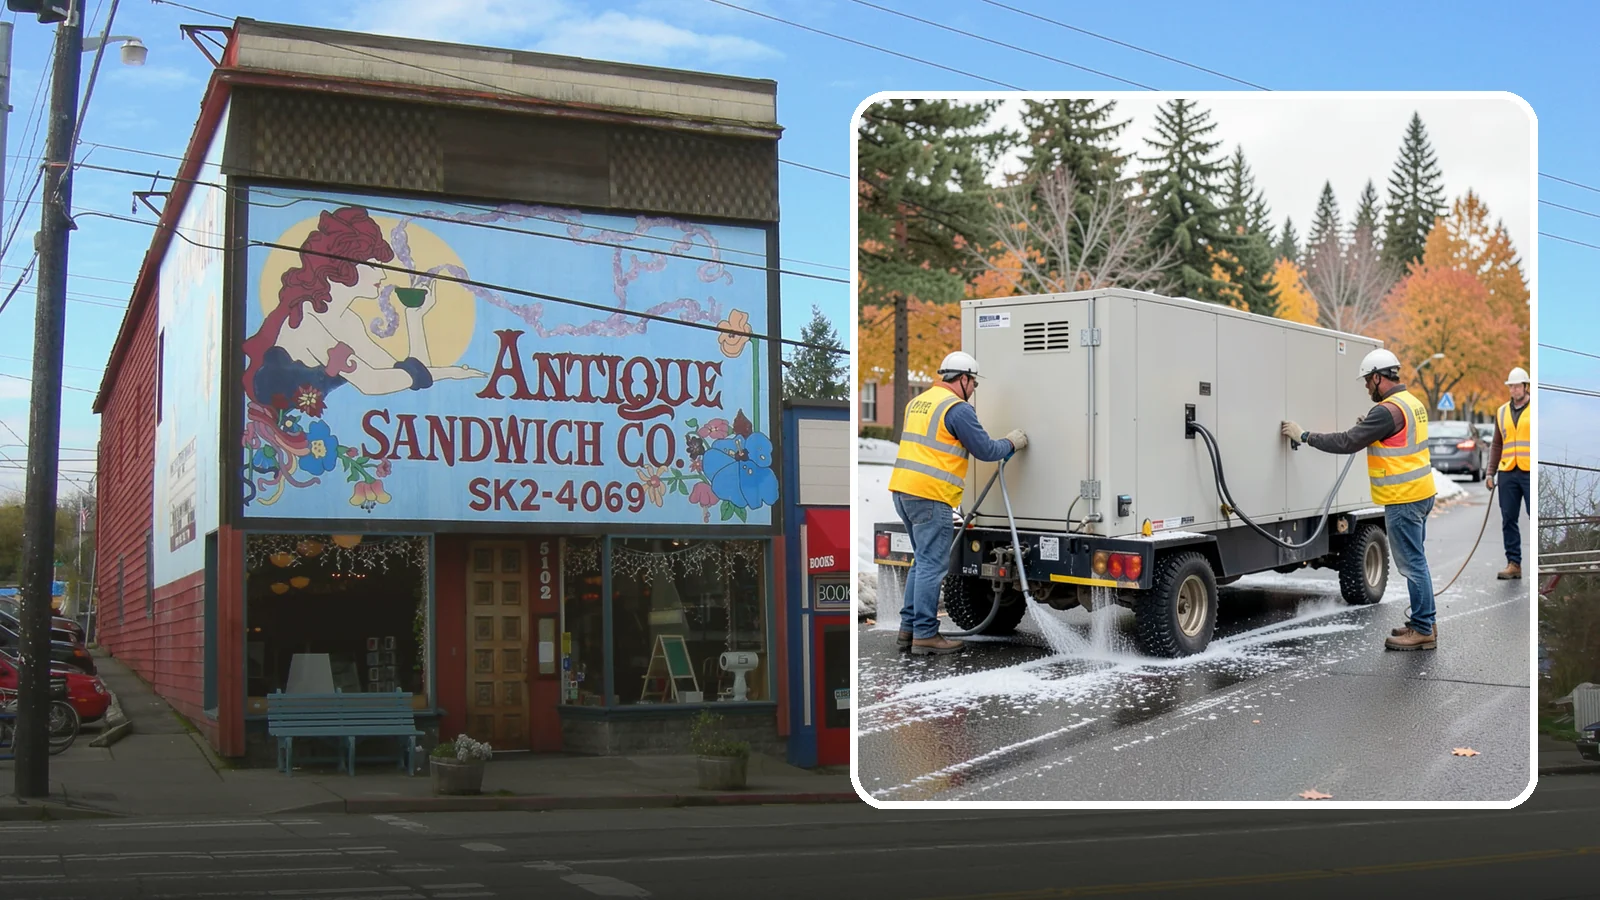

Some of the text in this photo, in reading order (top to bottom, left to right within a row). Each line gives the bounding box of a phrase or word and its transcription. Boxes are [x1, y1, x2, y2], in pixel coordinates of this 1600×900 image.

[475, 329, 723, 421] ANTIQUE
[360, 408, 685, 469] SANDWICH CO.
[468, 477, 646, 512] SK2-4069
[540, 541, 552, 599] 5102
[809, 556, 835, 569] BOOKS
